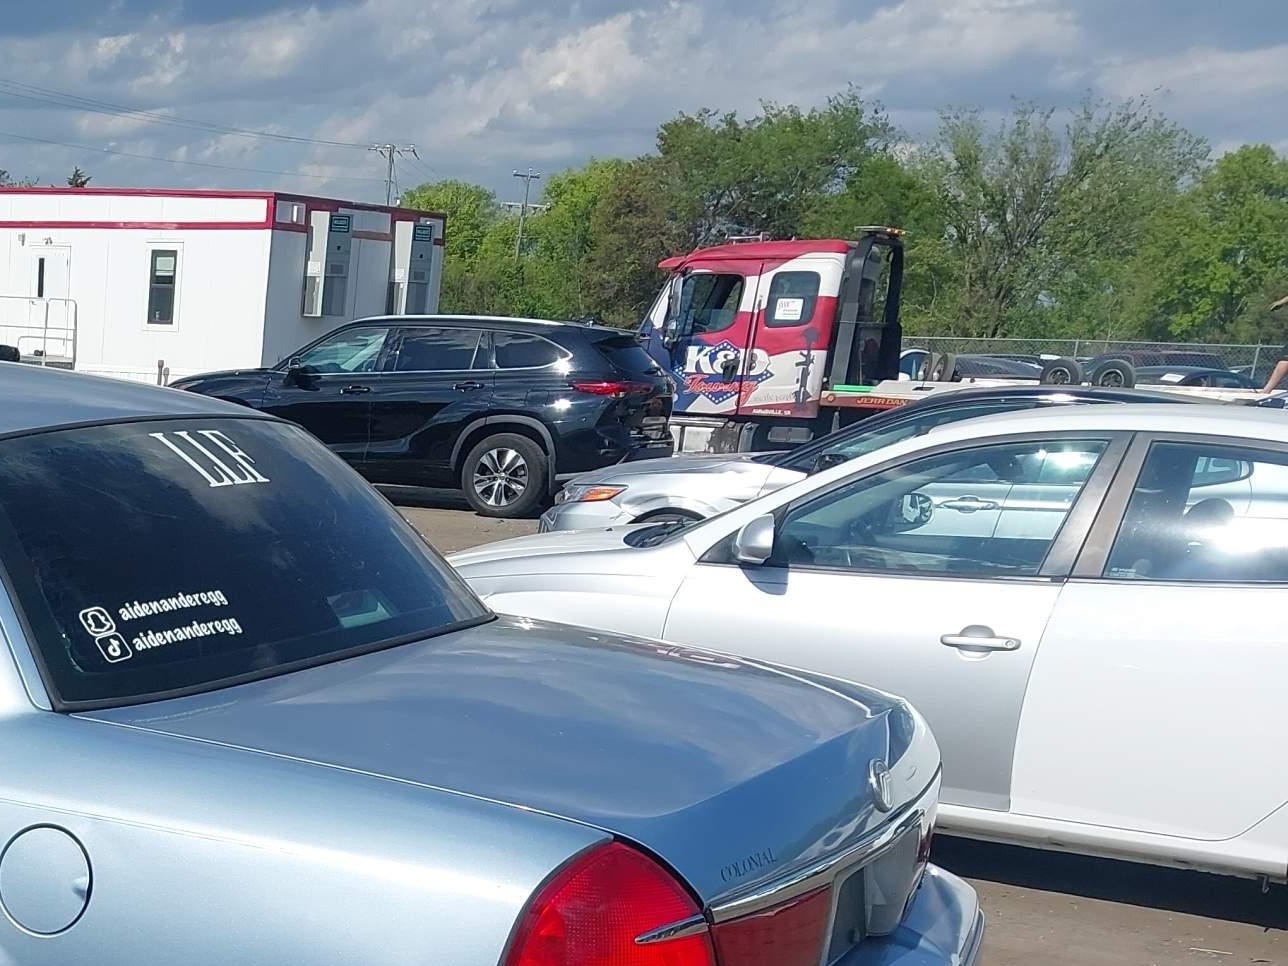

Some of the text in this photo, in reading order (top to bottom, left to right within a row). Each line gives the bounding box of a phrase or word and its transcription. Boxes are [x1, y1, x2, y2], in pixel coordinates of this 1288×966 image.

[118, 589, 229, 621] aidenanderegg
[132, 617, 243, 652] aidenanderegg
[720, 847, 777, 882] COLONIAL
